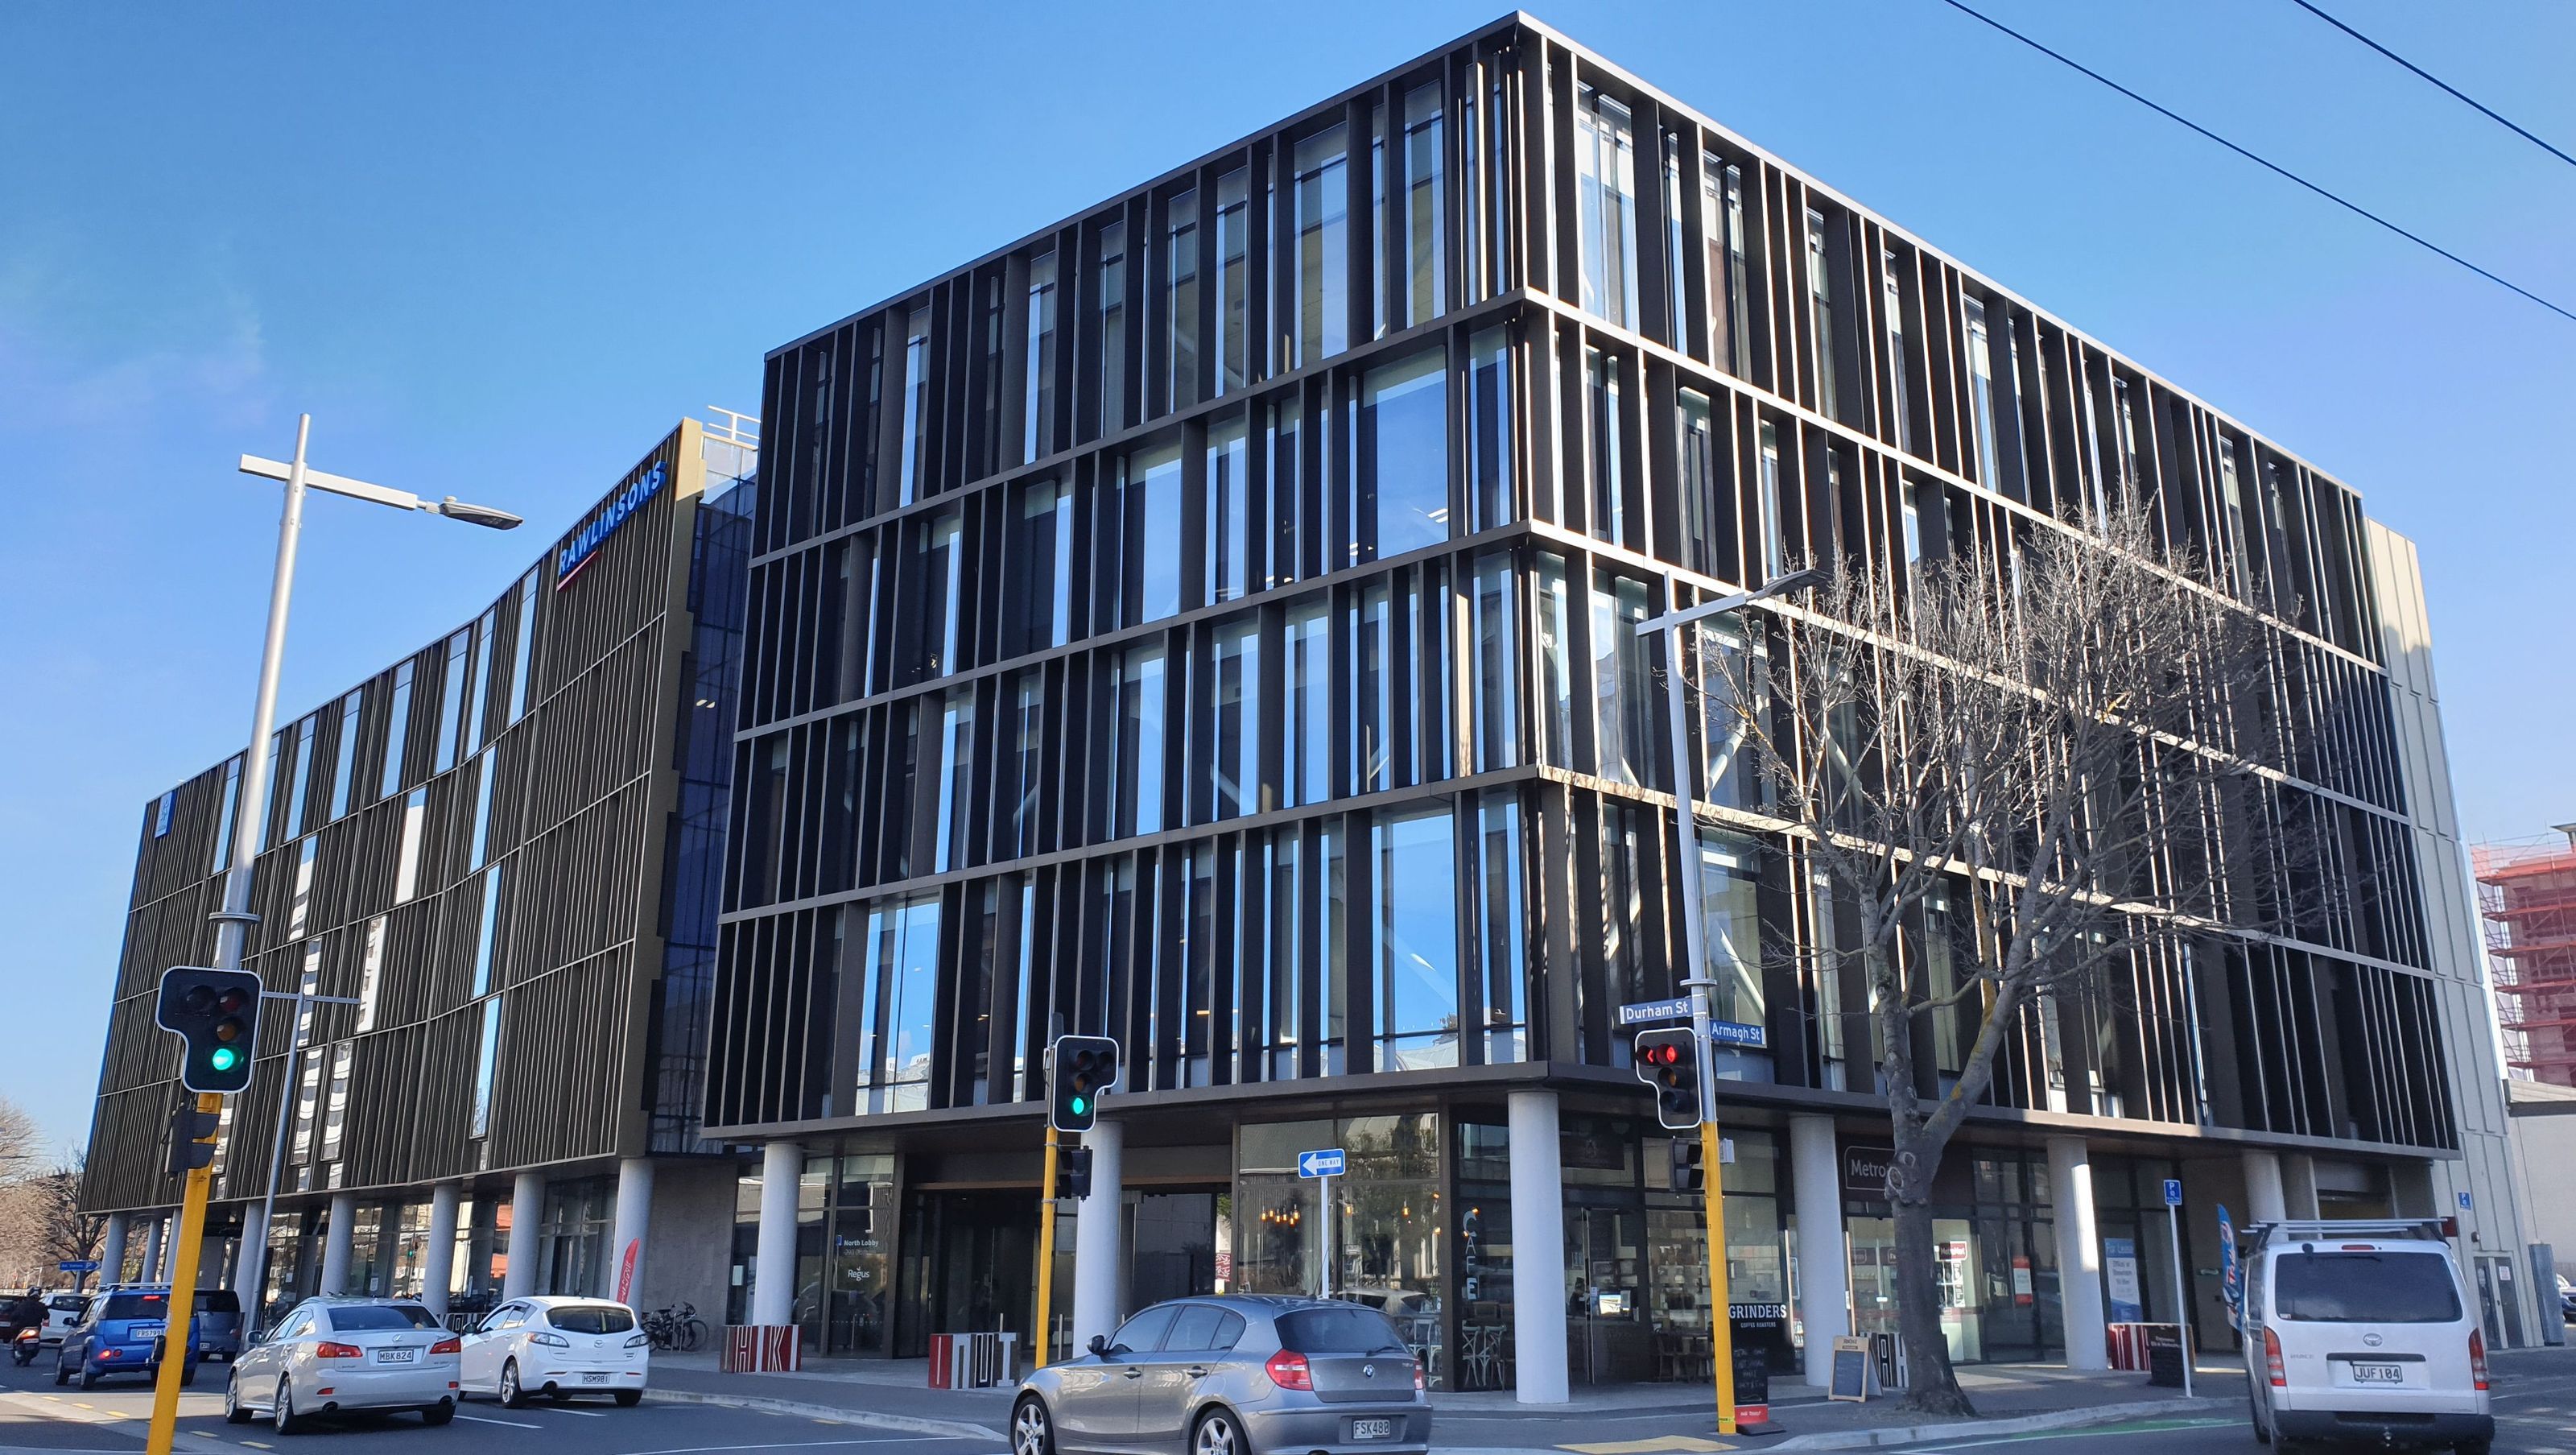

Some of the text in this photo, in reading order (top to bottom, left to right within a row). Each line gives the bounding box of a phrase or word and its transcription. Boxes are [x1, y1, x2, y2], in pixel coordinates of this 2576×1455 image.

[558, 460, 667, 575] RAWLINSONS
[1626, 1001, 1688, 1020] Durham St
[1711, 1023, 1760, 1042] Armagh St
[1852, 1159, 1889, 1177] Metro
[861, 1239, 878, 1247] Lobby
[1463, 1210, 1478, 1300] CAFE
[848, 1266, 870, 1281] Regus
[1728, 1304, 1787, 1319] GRINDERS
[379, 1350, 412, 1361] MBK824
[2355, 1368, 2401, 1380] JUF104
